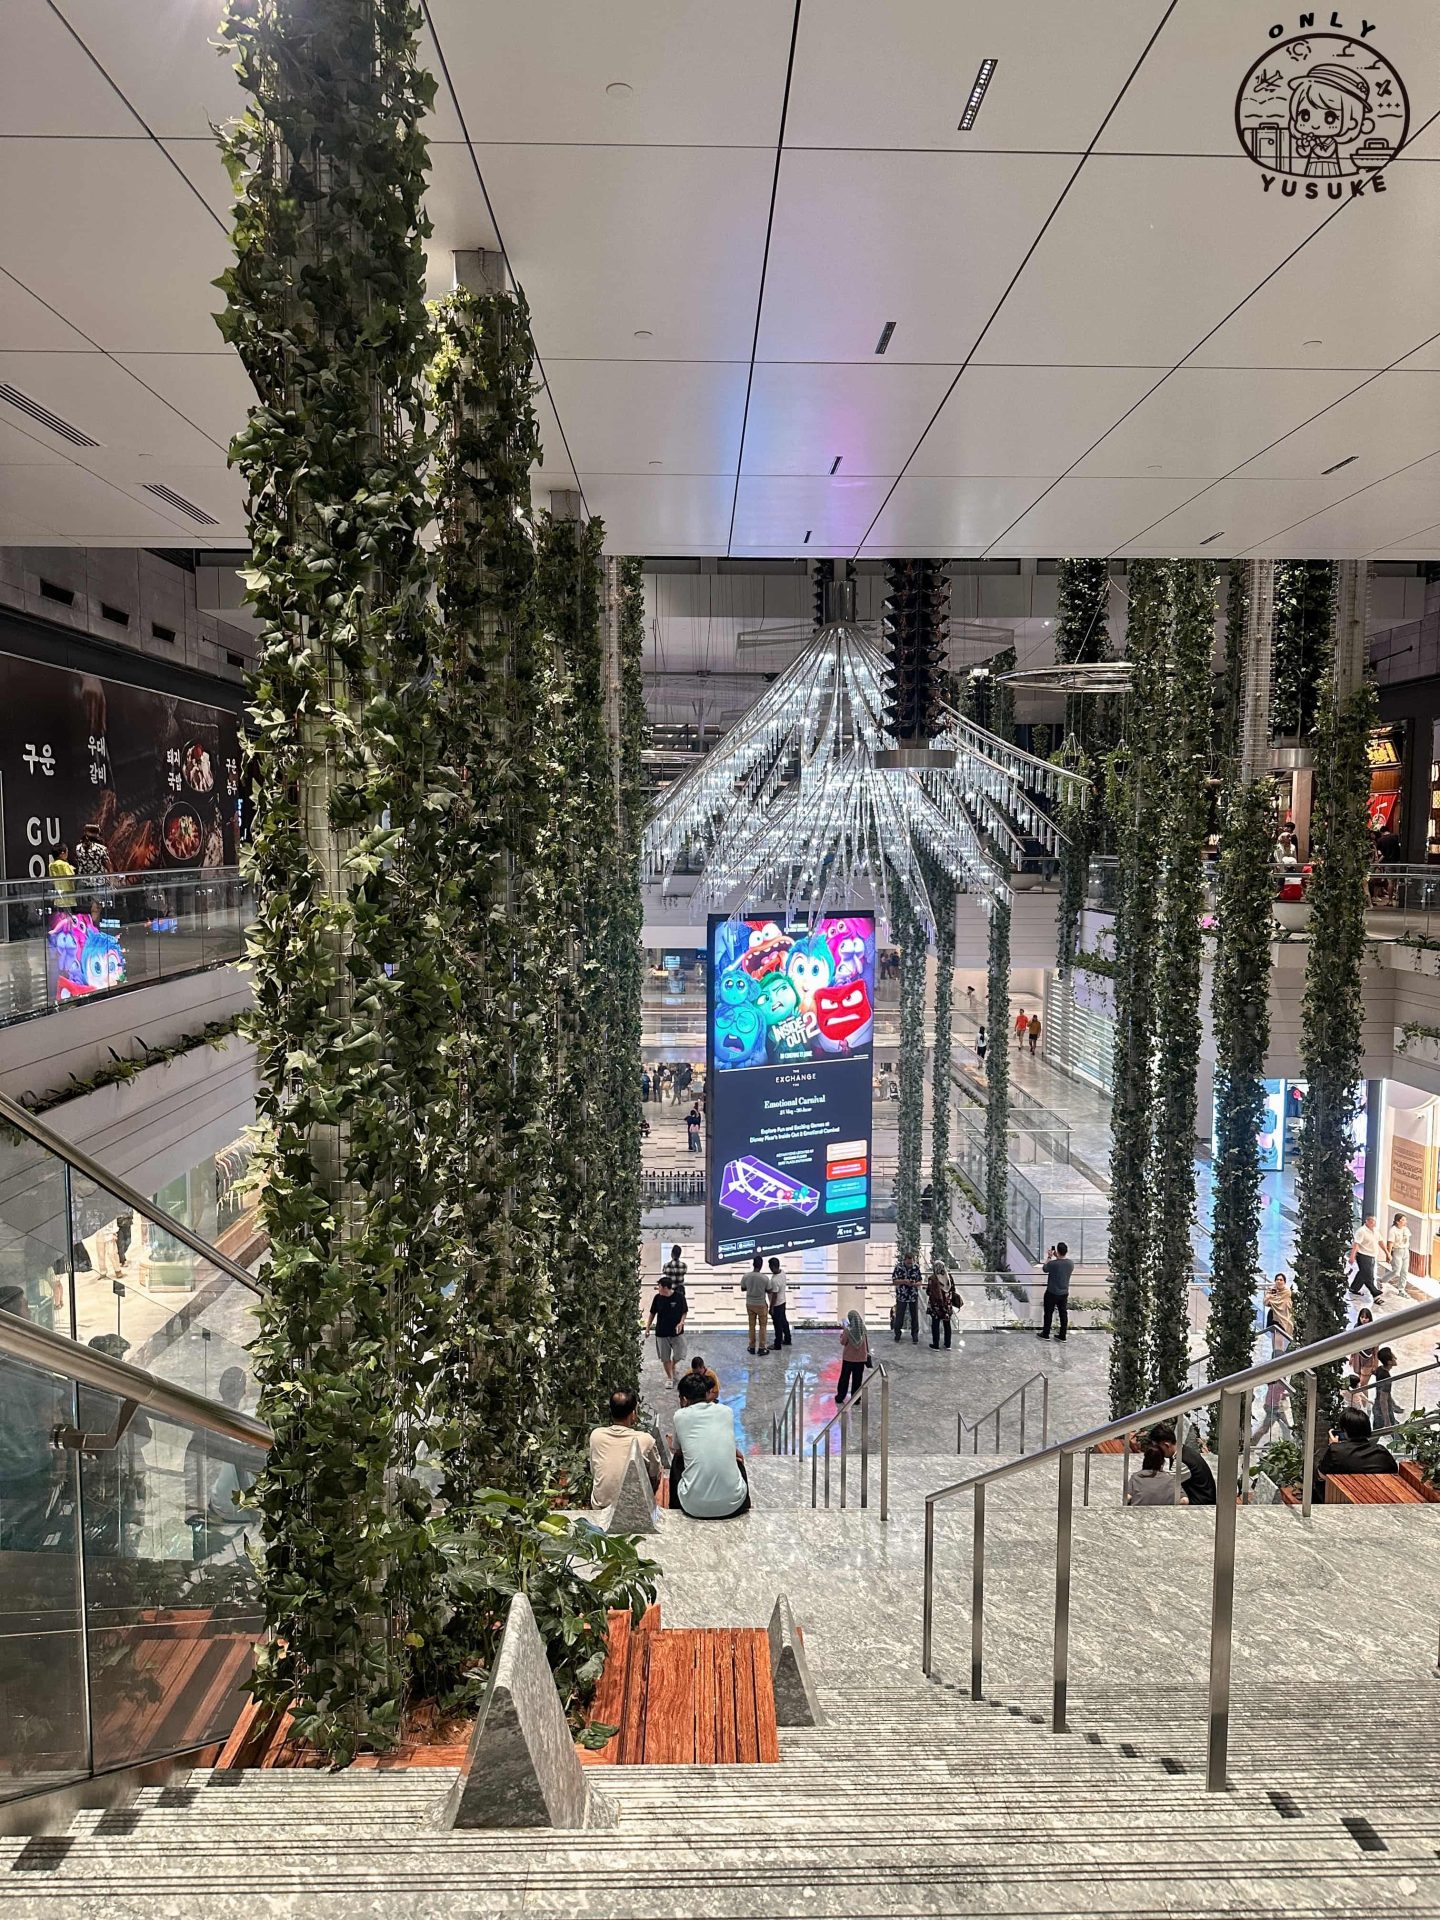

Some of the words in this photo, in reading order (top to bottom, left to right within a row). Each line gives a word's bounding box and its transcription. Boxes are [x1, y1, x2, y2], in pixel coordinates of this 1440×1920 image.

[87, 735, 106, 757] 우대
[22, 743, 56, 776] 구운
[89, 762, 107, 785] 갈비
[26, 816, 61, 846] GU
[771, 1016, 806, 1042] INSIDE
[802, 1011, 821, 1039] 2
[785, 1029, 808, 1048] OUT
[775, 1073, 817, 1083] EXCHANGE
[764, 1097, 798, 1109] Emotional
[798, 1094, 826, 1105] Carnival
